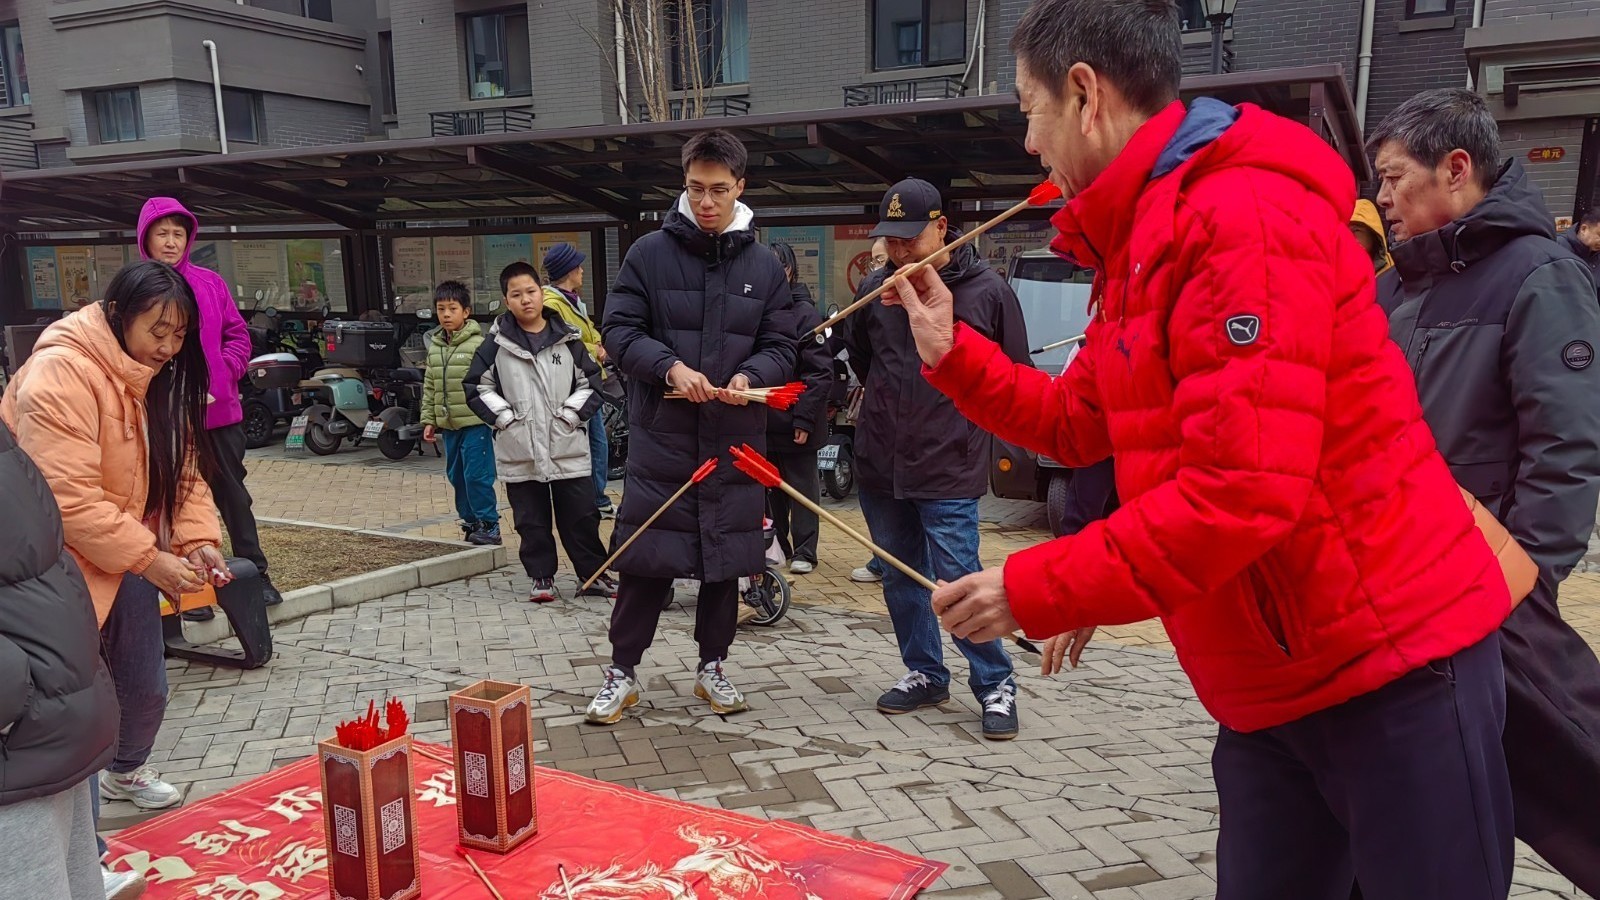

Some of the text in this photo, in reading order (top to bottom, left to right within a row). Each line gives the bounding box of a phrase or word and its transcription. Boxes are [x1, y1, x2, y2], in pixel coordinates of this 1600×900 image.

[1531, 148, 1561, 160] 二单元
[551, 352, 562, 365] NY
